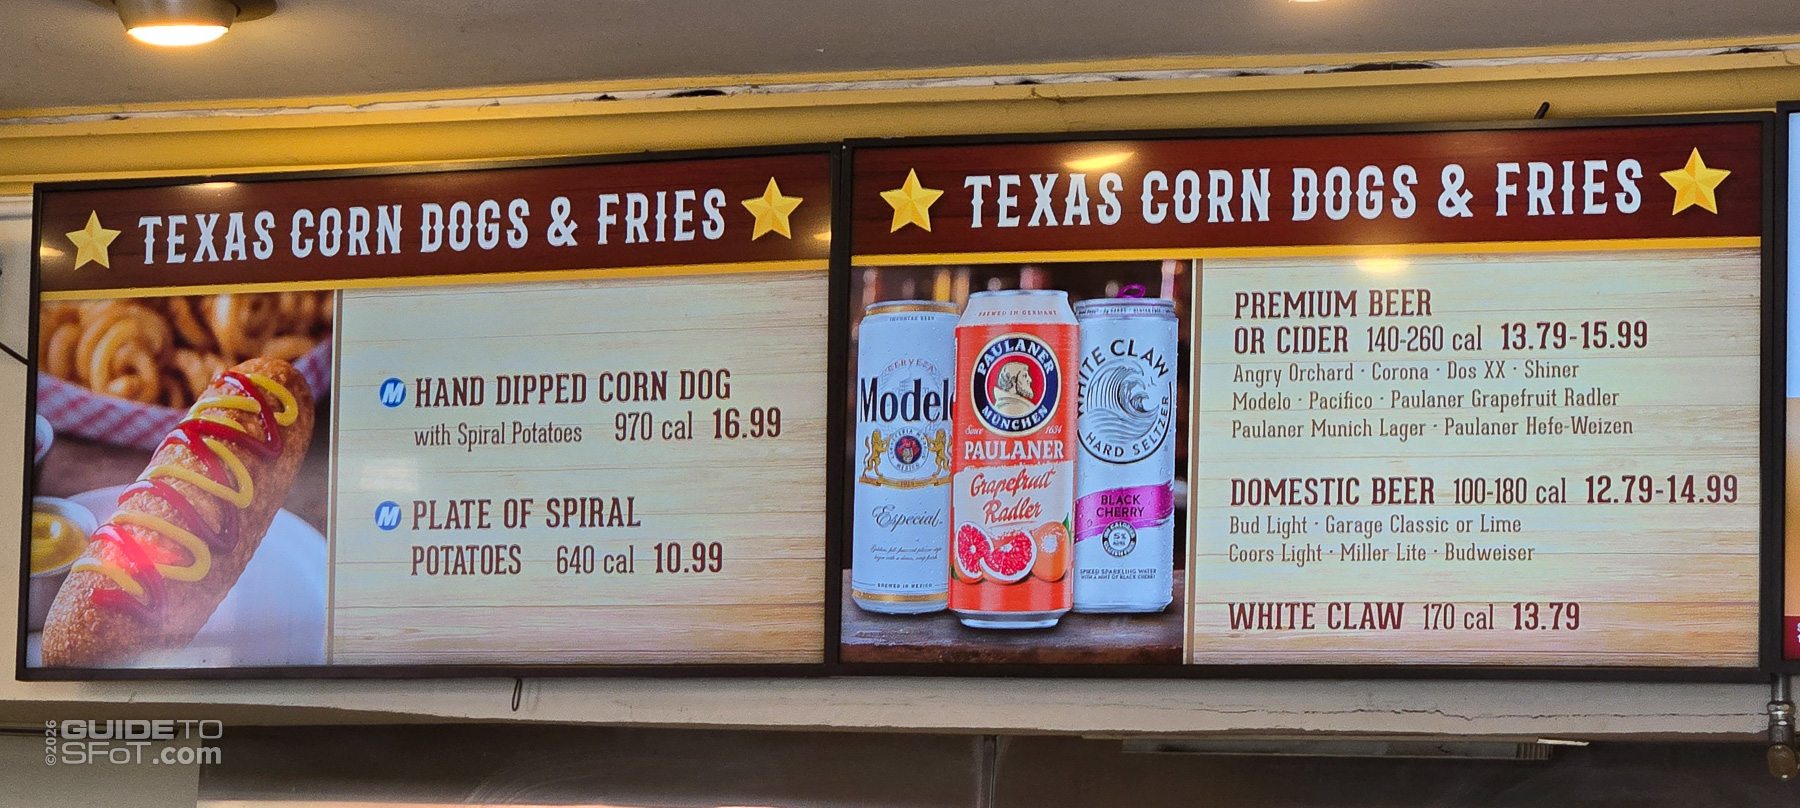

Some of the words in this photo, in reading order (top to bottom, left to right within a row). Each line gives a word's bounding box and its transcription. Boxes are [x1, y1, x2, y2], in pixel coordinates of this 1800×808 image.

[965, 172, 1123, 229] TEXAS
[1140, 167, 1271, 225] CORN
[1291, 164, 1419, 222] DOGS
[1439, 163, 1474, 218] &
[1495, 158, 1644, 217] FRIES
[138, 211, 276, 265] TEXAS
[290, 204, 402, 260] CORN
[420, 200, 530, 254] DOGS
[546, 196, 579, 247] &
[597, 188, 727, 245] FRIES
[1234, 289, 1358, 320] PREMIUM
[1368, 288, 1432, 318] BEER
[1233, 326, 1267, 355] OR
[1277, 325, 1349, 354] CIDER
[1367, 325, 1443, 353] 140-260
[1452, 325, 1483, 352] cal
[1500, 320, 1649, 351] 13.79-15.99
[887, 358, 935, 373] CERVEZA
[977, 338, 1055, 376] PAULANER
[1110, 339, 1169, 379] CLAW
[414, 376, 486, 408] HAND
[495, 373, 588, 406] DIPPED
[599, 371, 669, 403] CORN
[679, 368, 732, 401] DOG
[1232, 364, 1282, 388] Angry
[1288, 362, 1353, 383] Orchard
[1371, 362, 1429, 381] Corona
[1447, 361, 1477, 380] Dos
[1484, 360, 1506, 379] XX
[1524, 359, 1579, 379] Shiner
[860, 377, 954, 423] Model
[1232, 391, 1291, 411] Modelo
[1308, 390, 1373, 410] Pacifico
[1390, 389, 1465, 409] Paulaner
[1471, 388, 1557, 413] Grapefruit
[1564, 388, 1620, 408] Radler
[414, 424, 451, 447] with
[457, 421, 506, 452] Spiral
[511, 421, 582, 445] Potatoes
[614, 411, 653, 442] 970
[661, 410, 693, 441] cal
[713, 406, 782, 440] 16.99
[1045, 424, 1063, 434] 1634
[1086, 431, 1125, 458] HARD
[1132, 395, 1169, 456] SELTZER
[1231, 418, 1304, 439] Paulaner
[1311, 417, 1371, 438] Munich
[1379, 418, 1425, 442] Lager
[1444, 417, 1518, 436] Paulaner
[1526, 415, 1634, 436] Hefe-Weizen
[964, 440, 1065, 461] PAULANER
[970, 468, 1056, 498] Grapefruit
[1230, 476, 1360, 506] DOMESTIC
[1371, 476, 1435, 505] BEER
[1453, 476, 1528, 505] 100-180
[1535, 476, 1567, 505] cal
[1585, 474, 1739, 505] 12.79-14.99
[412, 499, 491, 531] PLATE
[503, 498, 534, 529] OF
[546, 496, 641, 528] SPIRAL
[983, 497, 1043, 525] Radler
[1096, 506, 1145, 518] CHERRY
[1101, 494, 1141, 506] BLACK
[1229, 515, 1260, 535] Bud
[1266, 515, 1308, 539] Light
[1325, 515, 1383, 539] Garage
[1390, 514, 1450, 534] Classic
[1455, 519, 1473, 534] or
[1480, 514, 1522, 534] Lime
[411, 543, 522, 576] POTATOES
[556, 544, 595, 575] 640
[603, 543, 635, 574] cal
[654, 541, 723, 574] 10.99
[1229, 544, 1274, 564] Coors
[1280, 543, 1323, 568] Light
[1340, 543, 1389, 563] Miller
[1395, 543, 1427, 562] Lite
[1445, 543, 1536, 562] Budweiser
[1228, 602, 1316, 631] WHITE
[1327, 602, 1405, 631] CLAW
[1423, 603, 1455, 630] 170
[1463, 603, 1494, 630] cal
[1513, 602, 1581, 630] 13.79
